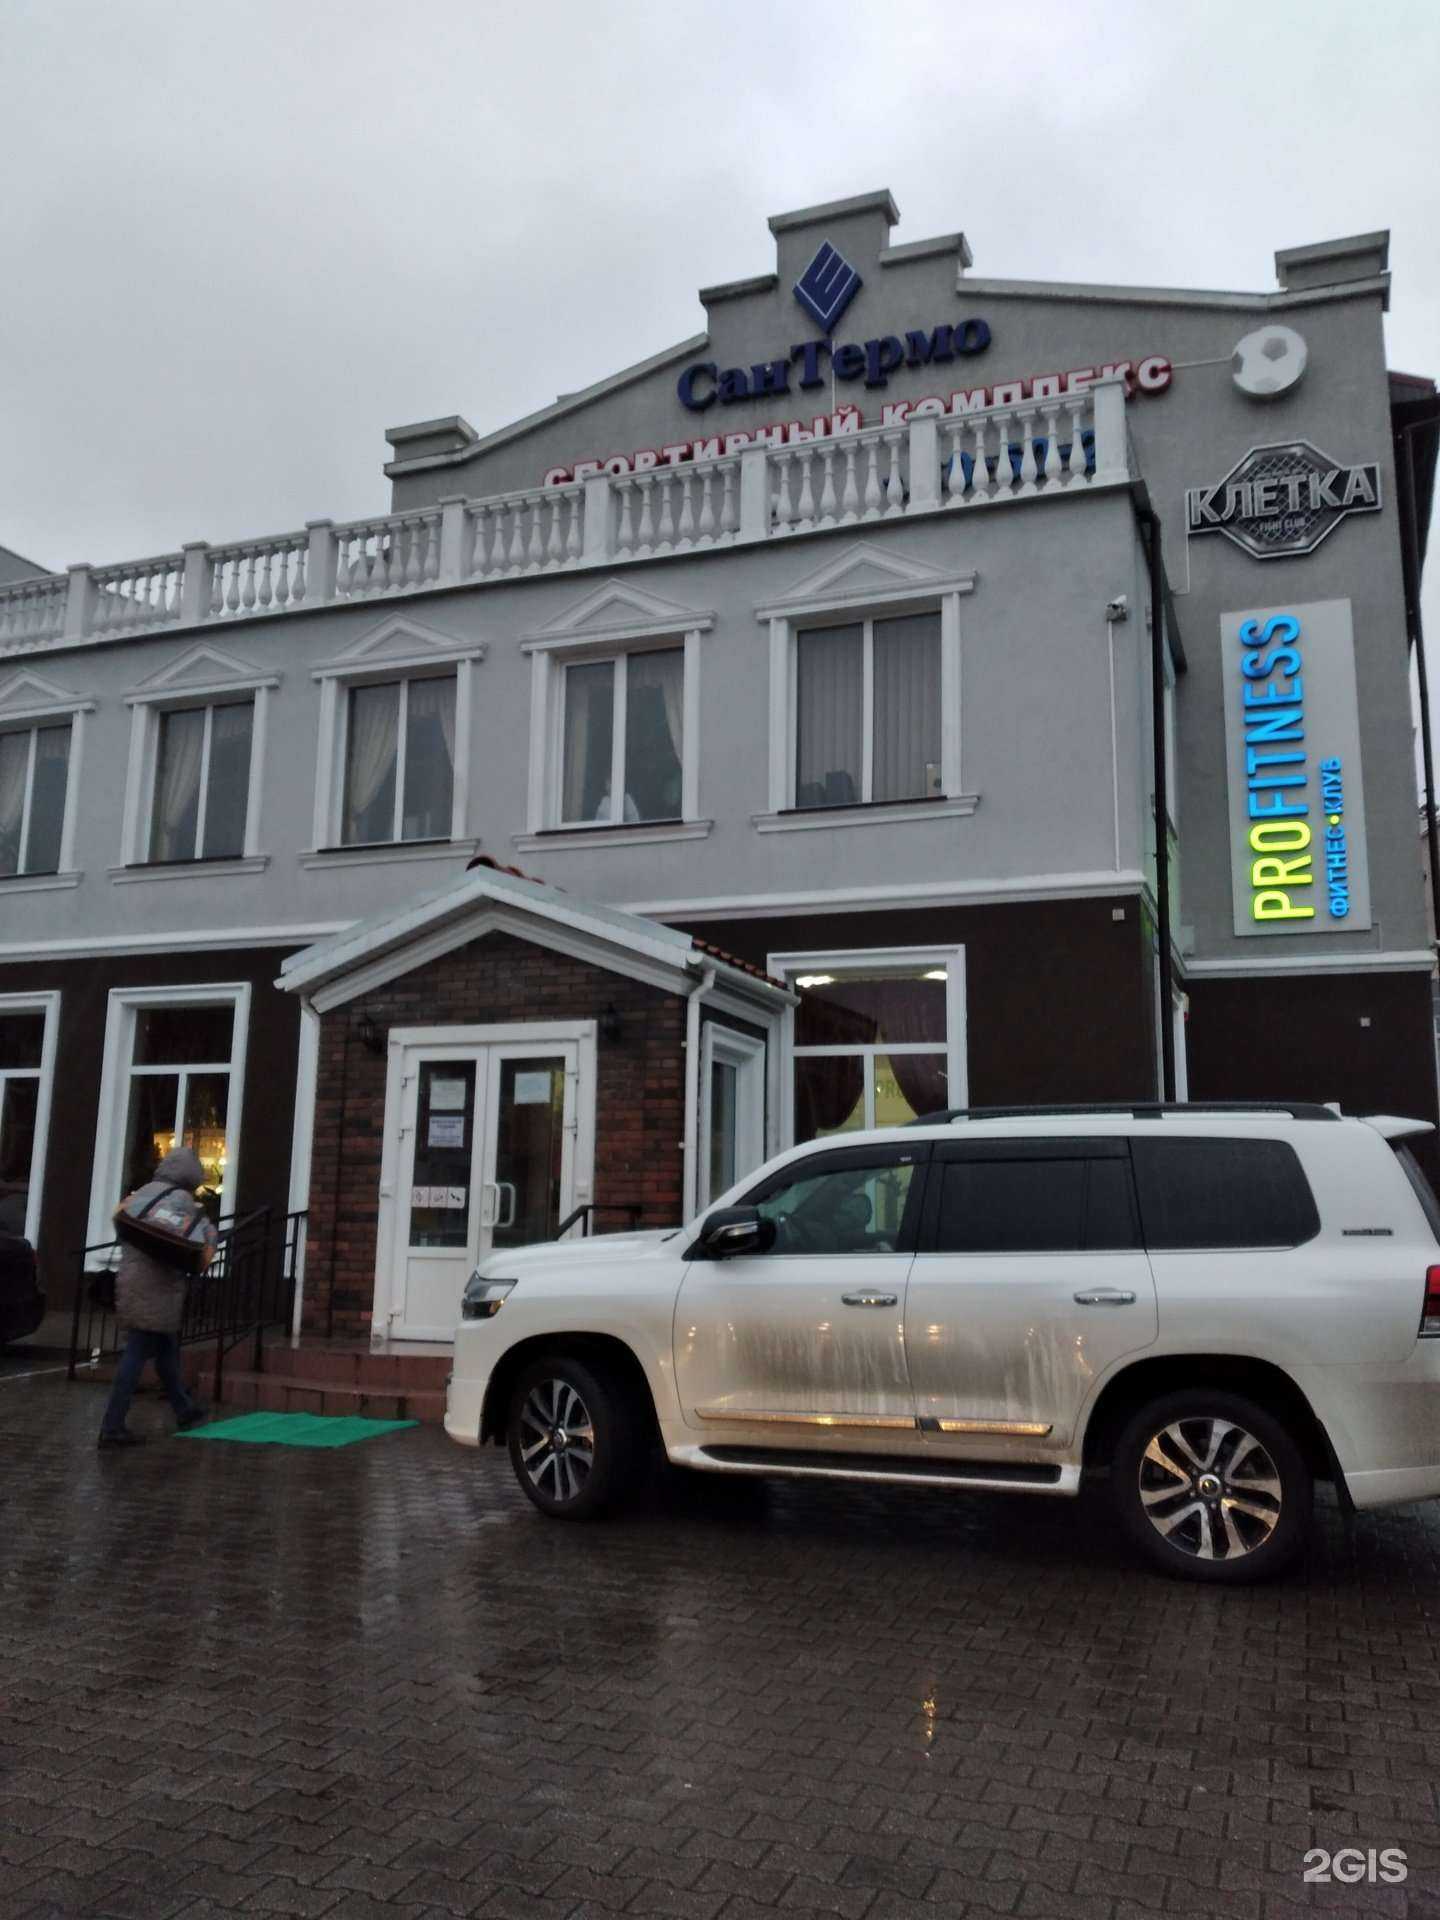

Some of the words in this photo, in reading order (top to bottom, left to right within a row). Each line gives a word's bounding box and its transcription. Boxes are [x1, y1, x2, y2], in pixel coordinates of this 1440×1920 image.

[677, 318, 992, 412] СанТермо
[1191, 468, 1376, 526] КЛЕТКА
[1239, 614, 1315, 921] PROFITNESS
